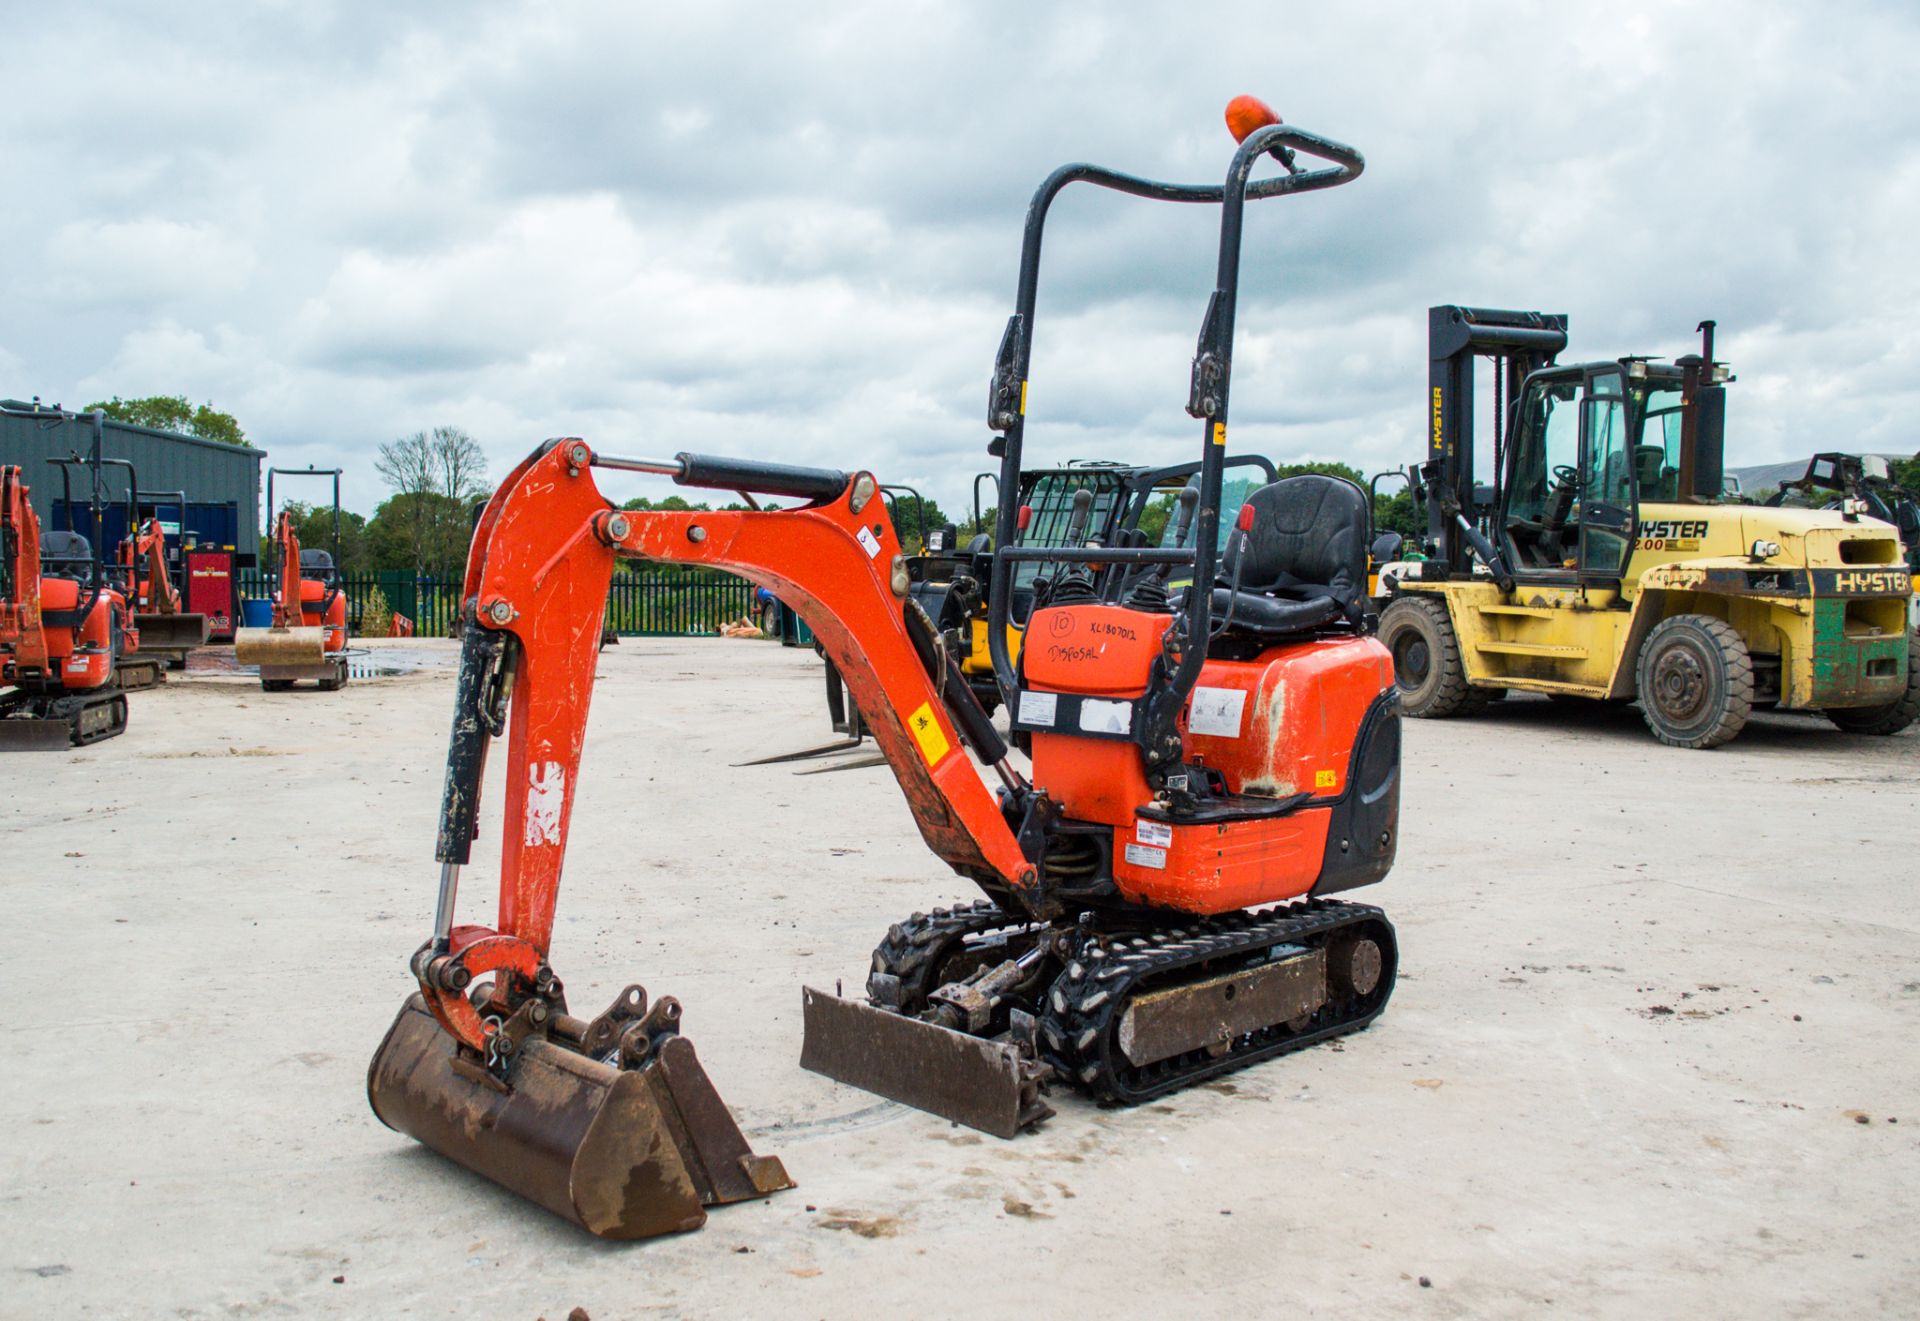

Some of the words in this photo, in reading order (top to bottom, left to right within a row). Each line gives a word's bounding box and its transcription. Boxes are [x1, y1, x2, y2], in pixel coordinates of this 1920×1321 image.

[1433, 387, 1442, 449] HYSTER
[1836, 572, 1908, 592] HYSTER
[1054, 616, 1069, 631] 10
[1048, 645, 1099, 662] DISPOSAL
